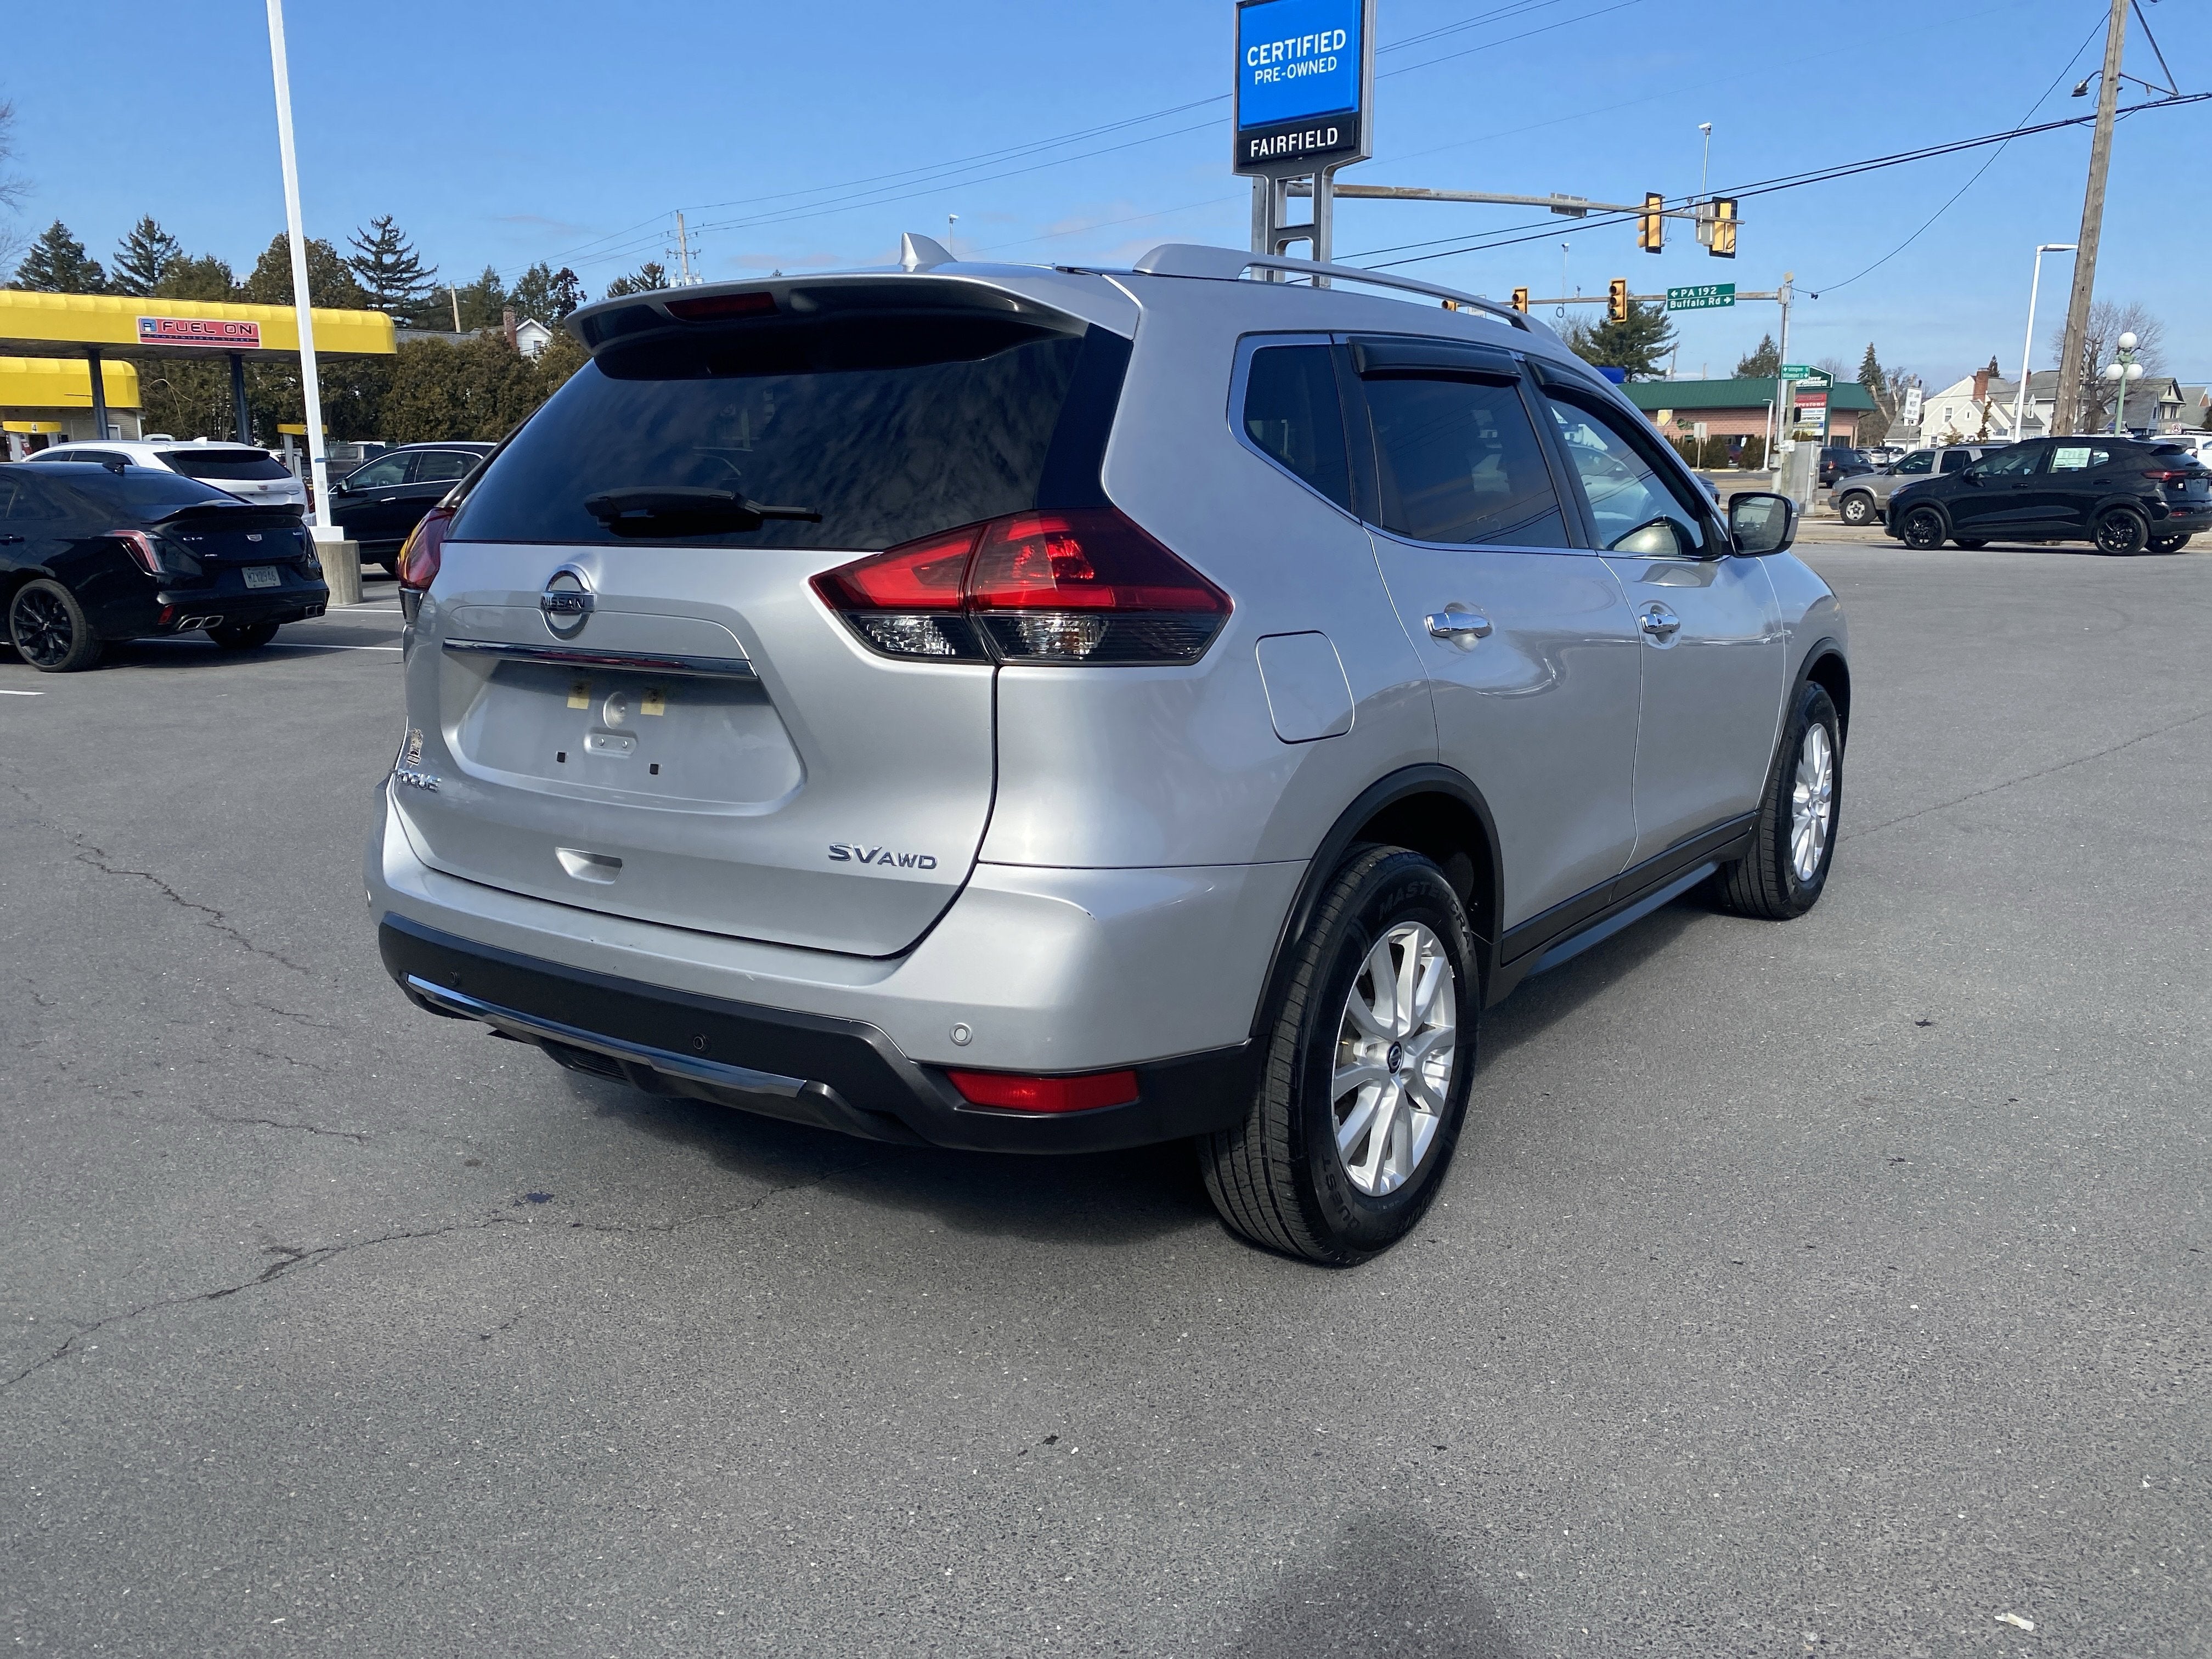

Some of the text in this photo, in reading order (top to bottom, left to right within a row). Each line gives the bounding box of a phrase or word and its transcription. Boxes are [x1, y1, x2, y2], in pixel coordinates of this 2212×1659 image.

[1247, 29, 1346, 66] CERTIFIED
[1255, 57, 1338, 85] PRE-OWNED
[1250, 127, 1339, 158] FAIRFIELD
[1681, 286, 1717, 297] PA 192
[1670, 297, 1720, 308] Buffalo Rd
[162, 321, 253, 335] FUEL ON
[32, 424, 37, 432] 4
[541, 596, 585, 611] NISSAN
[828, 842, 938, 870] SV AWD
